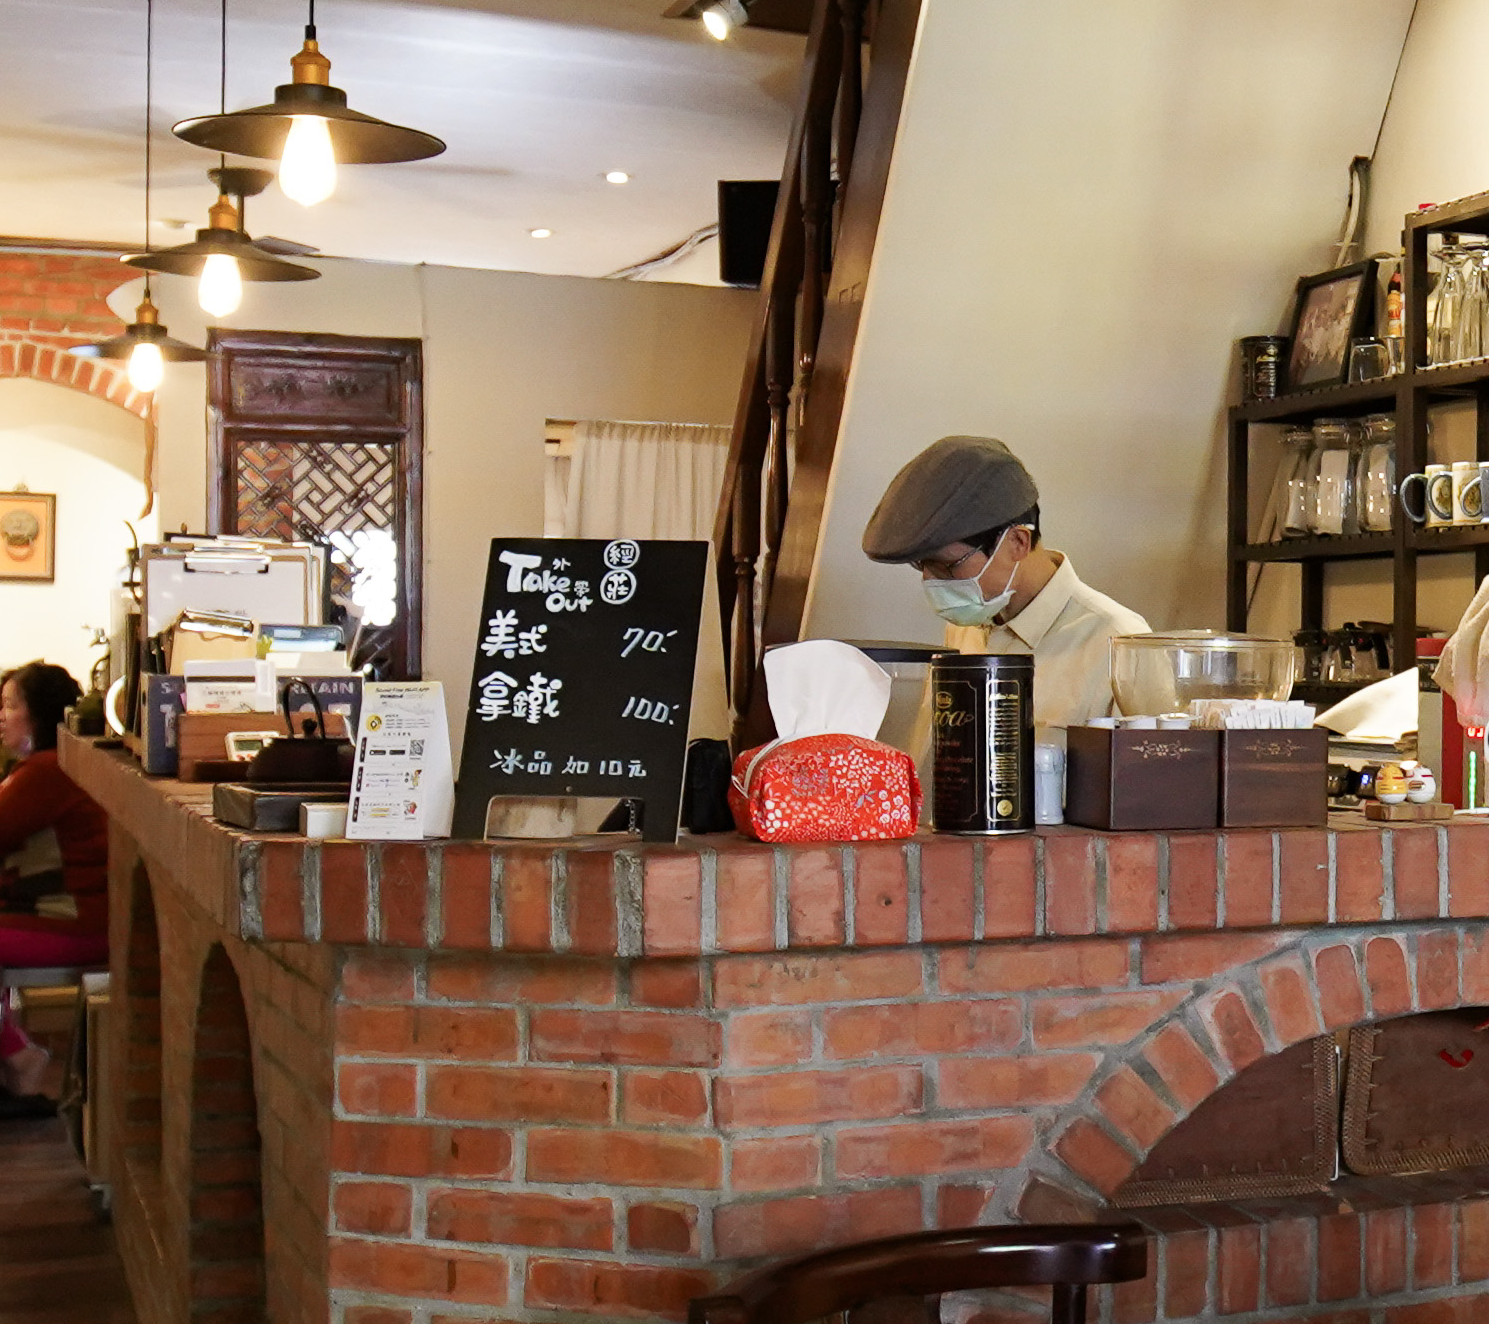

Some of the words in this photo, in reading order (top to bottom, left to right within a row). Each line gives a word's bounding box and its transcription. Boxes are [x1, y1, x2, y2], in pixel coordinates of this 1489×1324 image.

[498, 550, 571, 593] Take
[545, 594, 593, 613] Out
[480, 609, 548, 659] 美式
[476, 671, 563, 724] 拿鐵
[489, 748, 553, 775] 冰品
